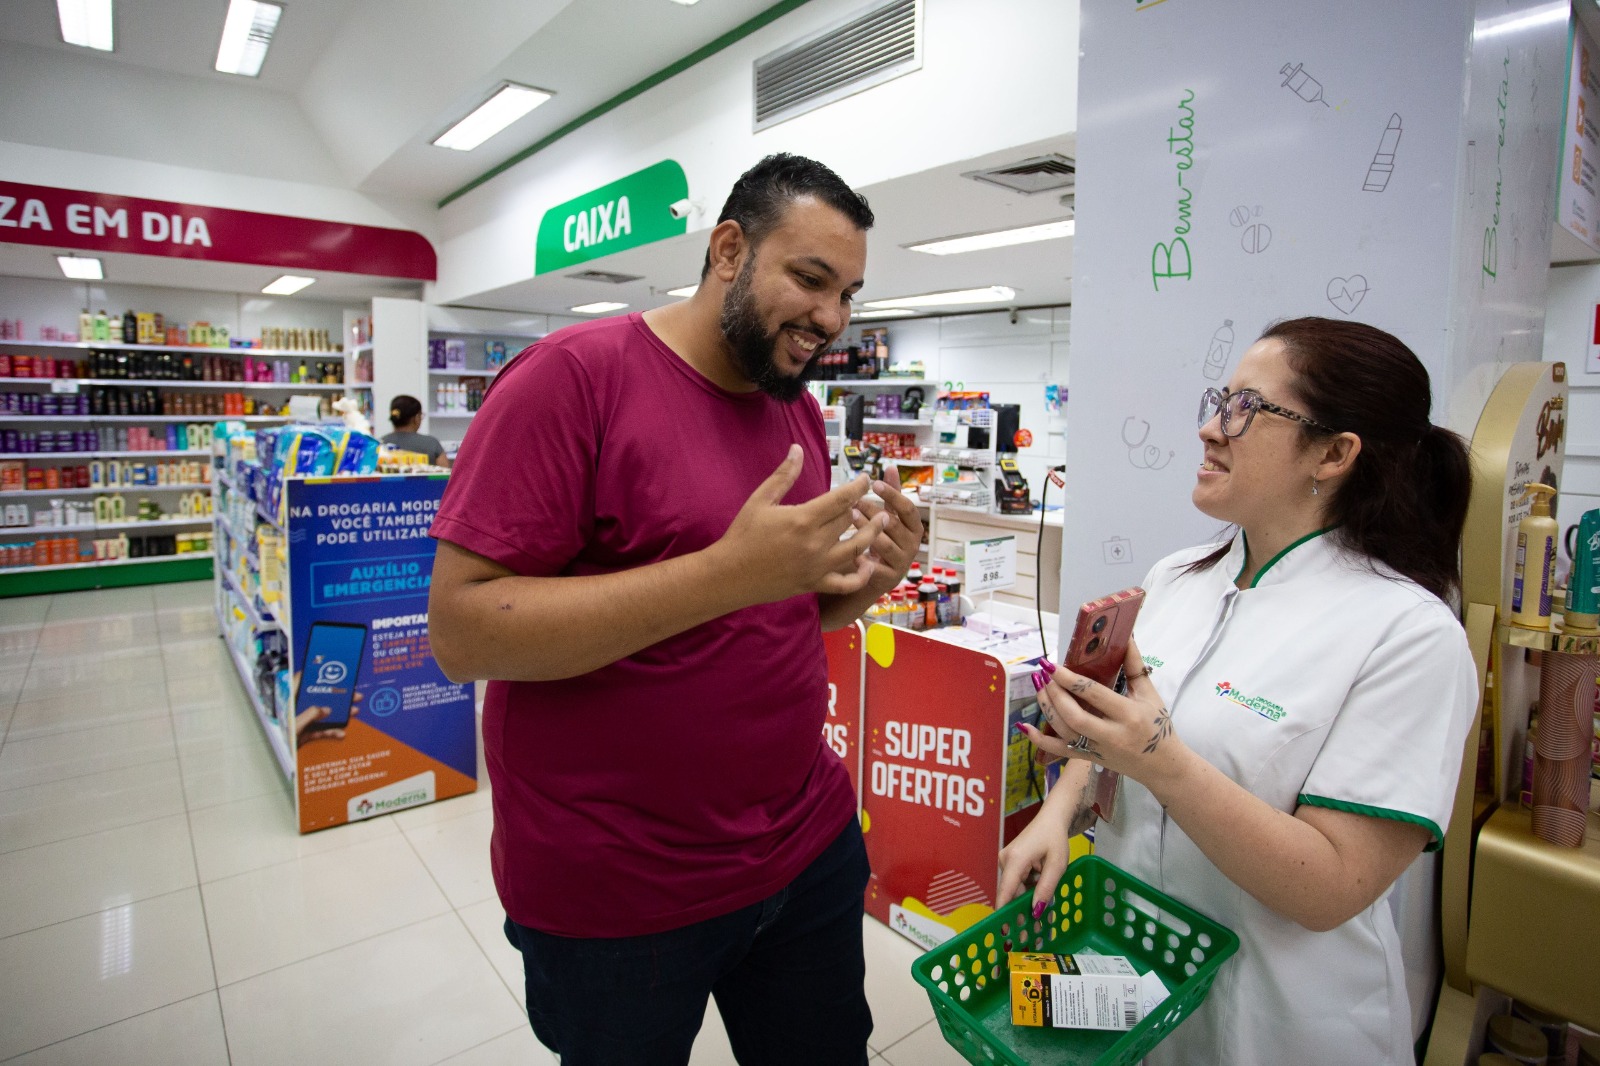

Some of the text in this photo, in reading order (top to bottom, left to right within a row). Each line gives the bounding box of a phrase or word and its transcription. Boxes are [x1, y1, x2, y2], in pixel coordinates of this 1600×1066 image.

[1152, 88, 1194, 291] Bem-estar
[66, 204, 128, 239] EM
[142, 211, 212, 248] DIA
[563, 195, 632, 253] CAIXA
[290, 506, 313, 518] NA
[317, 501, 397, 517] DROGARIA
[331, 512, 434, 530] VOCÊ TAMBÉM
[316, 527, 428, 546] PODE UTILIZAR
[350, 561, 420, 581] AUXÍLIO
[372, 631, 405, 642] ESTEJA
[406, 628, 420, 638] EM
[388, 646, 408, 656] COM
[885, 721, 971, 769] SUPER
[871, 761, 985, 817] OFERTAS
[375, 792, 427, 811] Moderna
[1029, 988, 1040, 999] D
